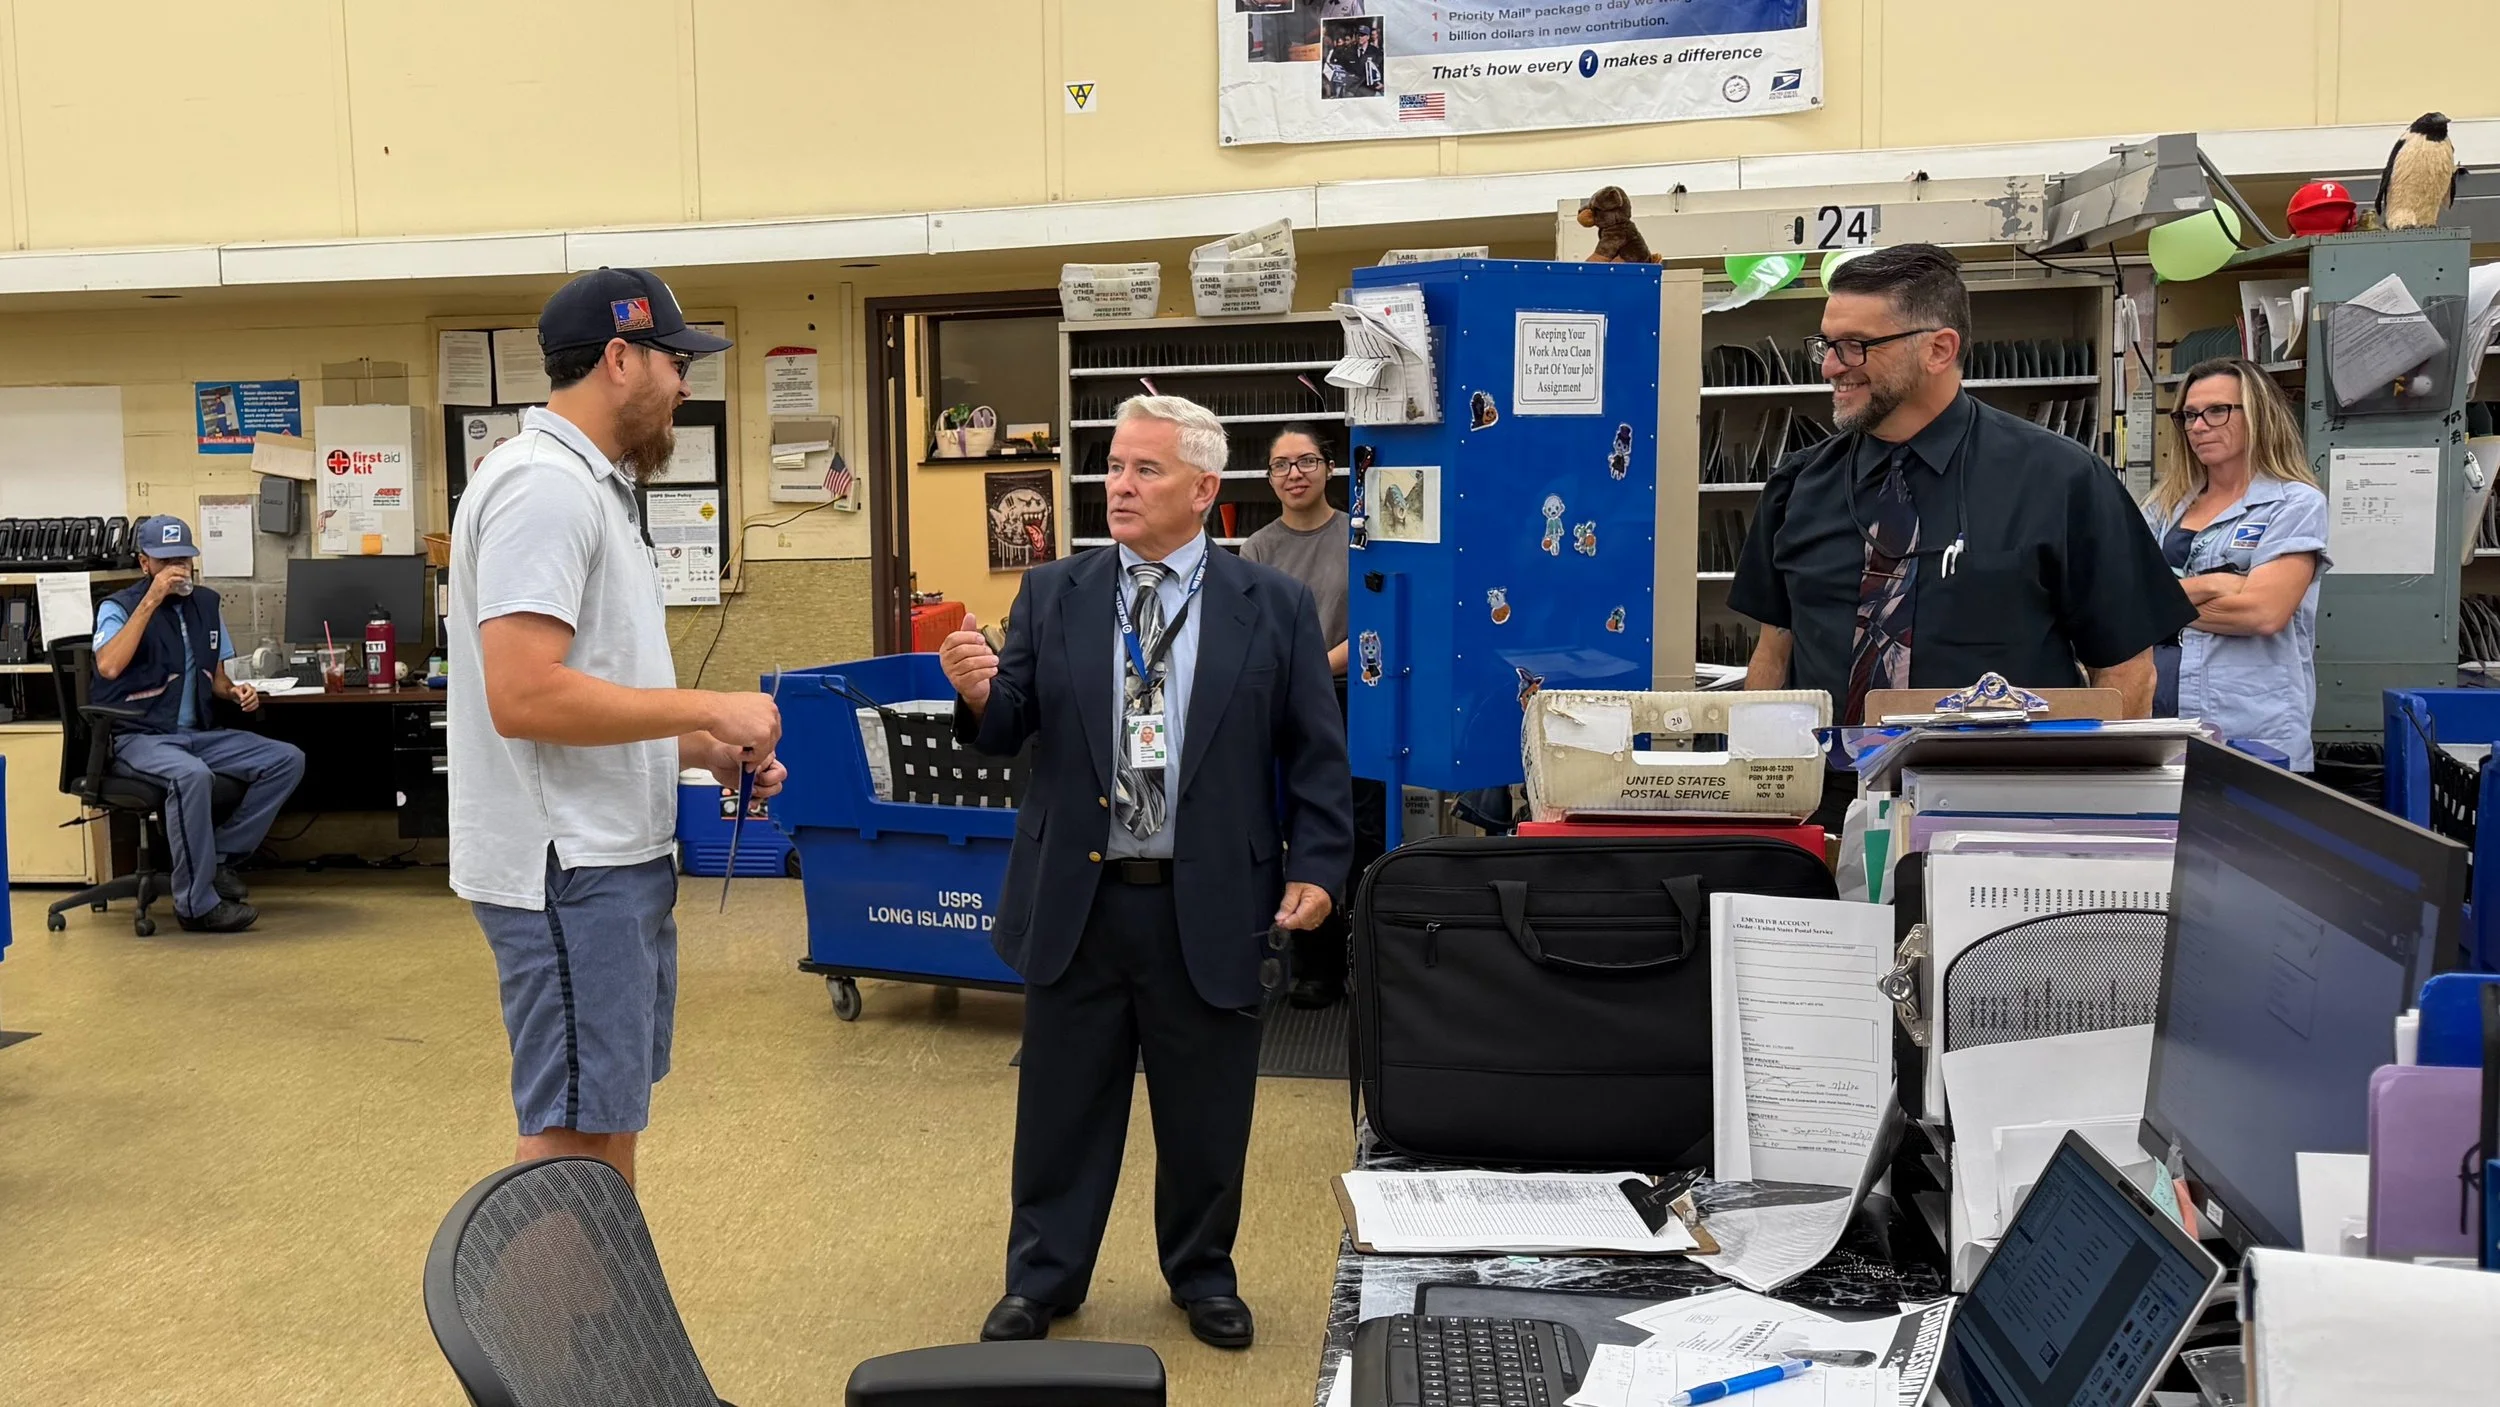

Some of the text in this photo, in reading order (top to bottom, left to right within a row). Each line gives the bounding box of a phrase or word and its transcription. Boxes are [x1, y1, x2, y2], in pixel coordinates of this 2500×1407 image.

[1432, 12, 1438, 21] 1
[1449, 11, 1494, 24] Priority
[1535, 4, 1590, 18] package
[1608, 0, 1630, 10] day
[1432, 16, 1669, 41] 1 billion dollars in new contribution.
[1487, 60, 1522, 76] how
[1527, 58, 1572, 74] every
[1604, 51, 1658, 68] makes
[1663, 54, 1672, 64] a
[1678, 47, 1762, 63] difference
[2322, 184, 2336, 198] P
[1818, 206, 1867, 249] 24
[1536, 328, 1586, 342] Keeping Your
[1528, 346, 1590, 356] Work Area Clean
[1526, 364, 1594, 377] Is Part Of Your Job
[1537, 381, 1581, 395] Assignment
[353, 452, 400, 463] first aid
[354, 464, 372, 474] kit
[1671, 717, 1682, 726] 20
[1626, 776, 1726, 786] UNITED STATES
[1620, 790, 1730, 800] POSTAL SERVICE
[938, 891, 983, 909] USPS
[868, 906, 996, 931] LONG ISLAND D
[1898, 1304, 1947, 1392] CONGRESSMAN
